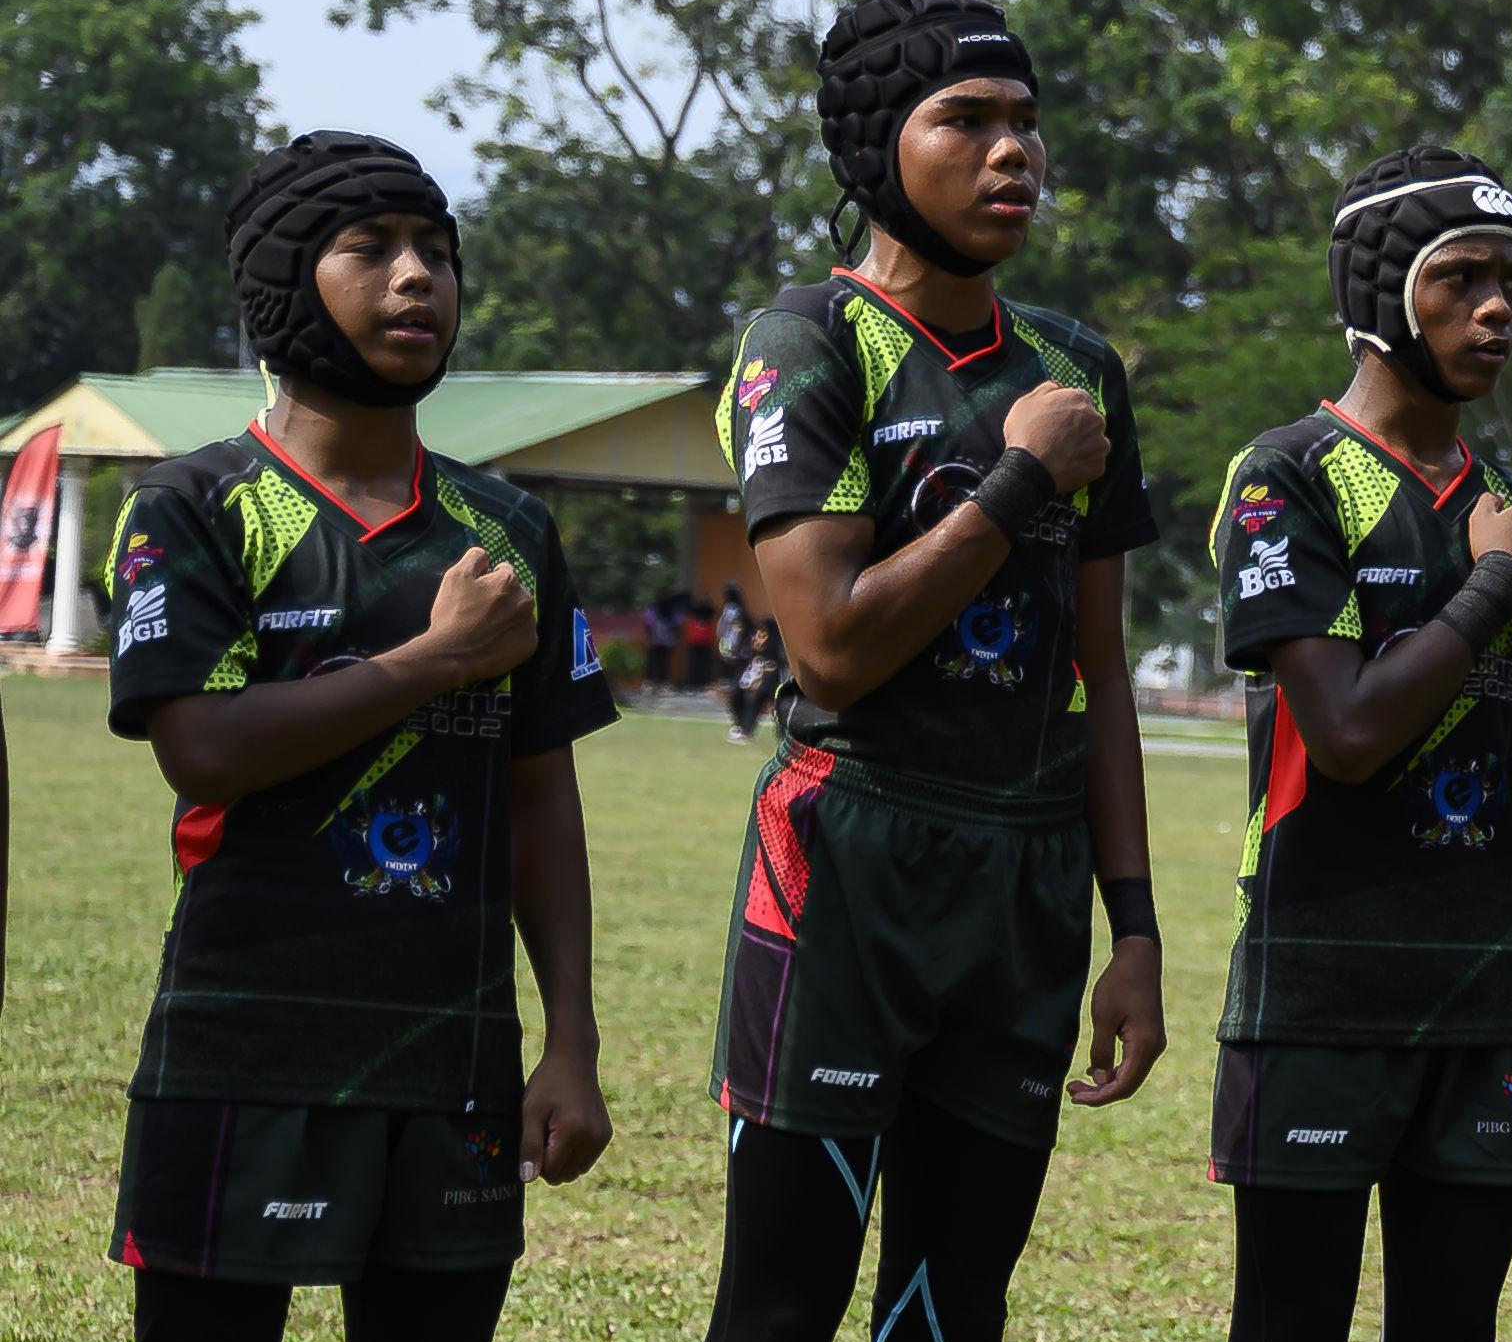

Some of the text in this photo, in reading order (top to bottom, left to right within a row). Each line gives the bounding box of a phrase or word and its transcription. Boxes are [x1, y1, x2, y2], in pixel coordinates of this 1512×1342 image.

[1238, 566, 1296, 600] BGE
[257, 608, 342, 633] FORFIT
[117, 619, 168, 658] BGE
[810, 1067, 881, 1089] FORFIT
[1286, 1128, 1349, 1146] FORFIT
[1476, 1121, 1511, 1134] PIBG
[443, 1188, 478, 1207] PIBG
[262, 1201, 328, 1219] FORFIT
